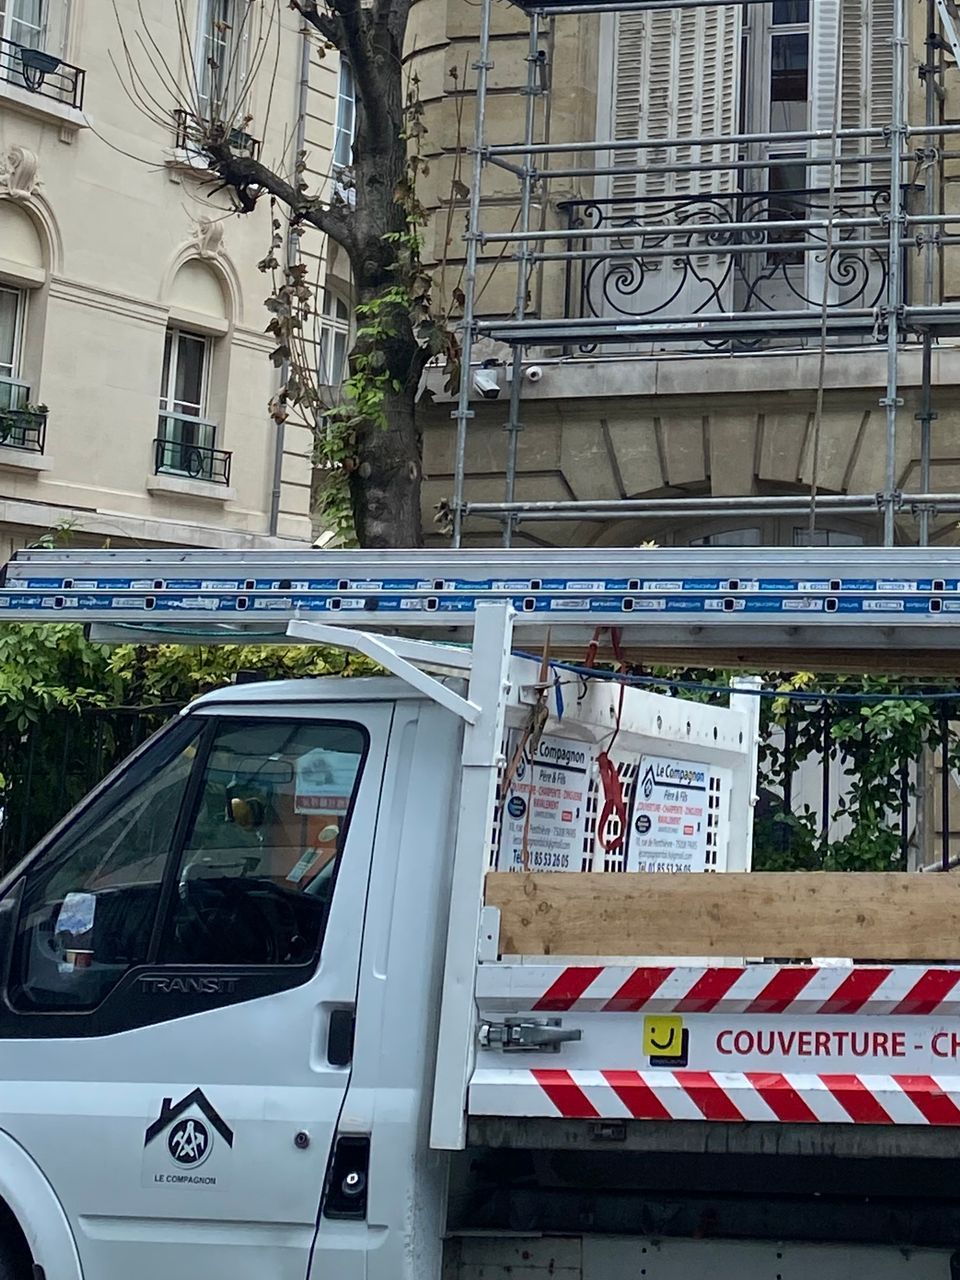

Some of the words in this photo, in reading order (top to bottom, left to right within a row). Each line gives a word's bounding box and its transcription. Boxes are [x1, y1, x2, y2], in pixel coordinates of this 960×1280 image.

[656, 763, 664, 778] Le
[665, 764, 705, 785] Compagnon
[139, 977, 240, 993] TRANSIT
[716, 1030, 906, 1057] COUVERTURE
[154, 1174, 165, 1183] LE
[166, 1175, 216, 1185] COMPAGNON
